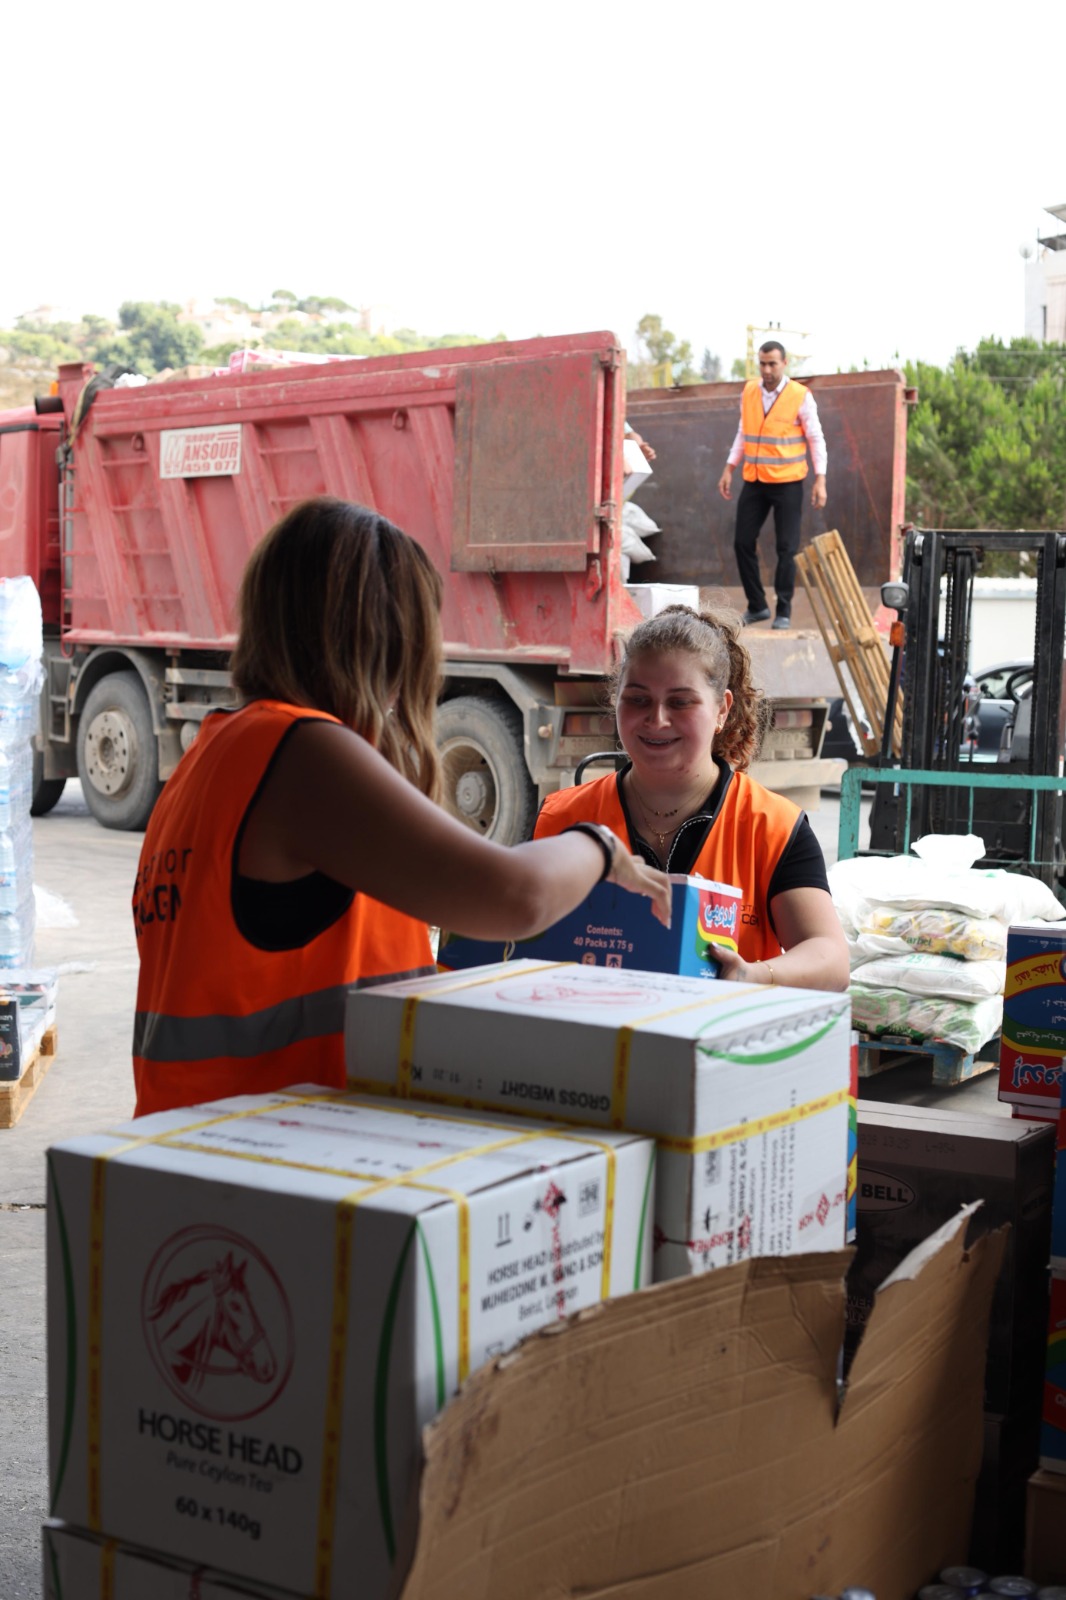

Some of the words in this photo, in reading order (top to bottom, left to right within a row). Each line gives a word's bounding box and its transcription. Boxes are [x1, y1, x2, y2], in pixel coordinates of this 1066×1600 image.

[704, 901, 738, 936] إندومي
[586, 924, 623, 937] Contents:
[573, 937, 584, 947] 40
[585, 938, 608, 949] Packs
[617, 940, 627, 951] 75
[627, 942, 634, 952] g
[906, 936, 932, 948] arbel
[906, 954, 924, 964] 25
[1031, 959, 1059, 977] خضار
[410, 1065, 423, 1081] K
[500, 1080, 556, 1103] WEIGHT
[559, 1088, 611, 1112] GROSS
[861, 1183, 908, 1203] BELL
[847, 1295, 873, 1308] WER
[137, 1407, 222, 1456] HORSE
[227, 1431, 304, 1475] HEAD
[166, 1450, 198, 1474] Pure
[198, 1459, 247, 1486] Ceylon
[249, 1472, 274, 1494] Tea
[175, 1495, 199, 1518] 60
[201, 1505, 213, 1523] x
[217, 1506, 262, 1541] 140g
